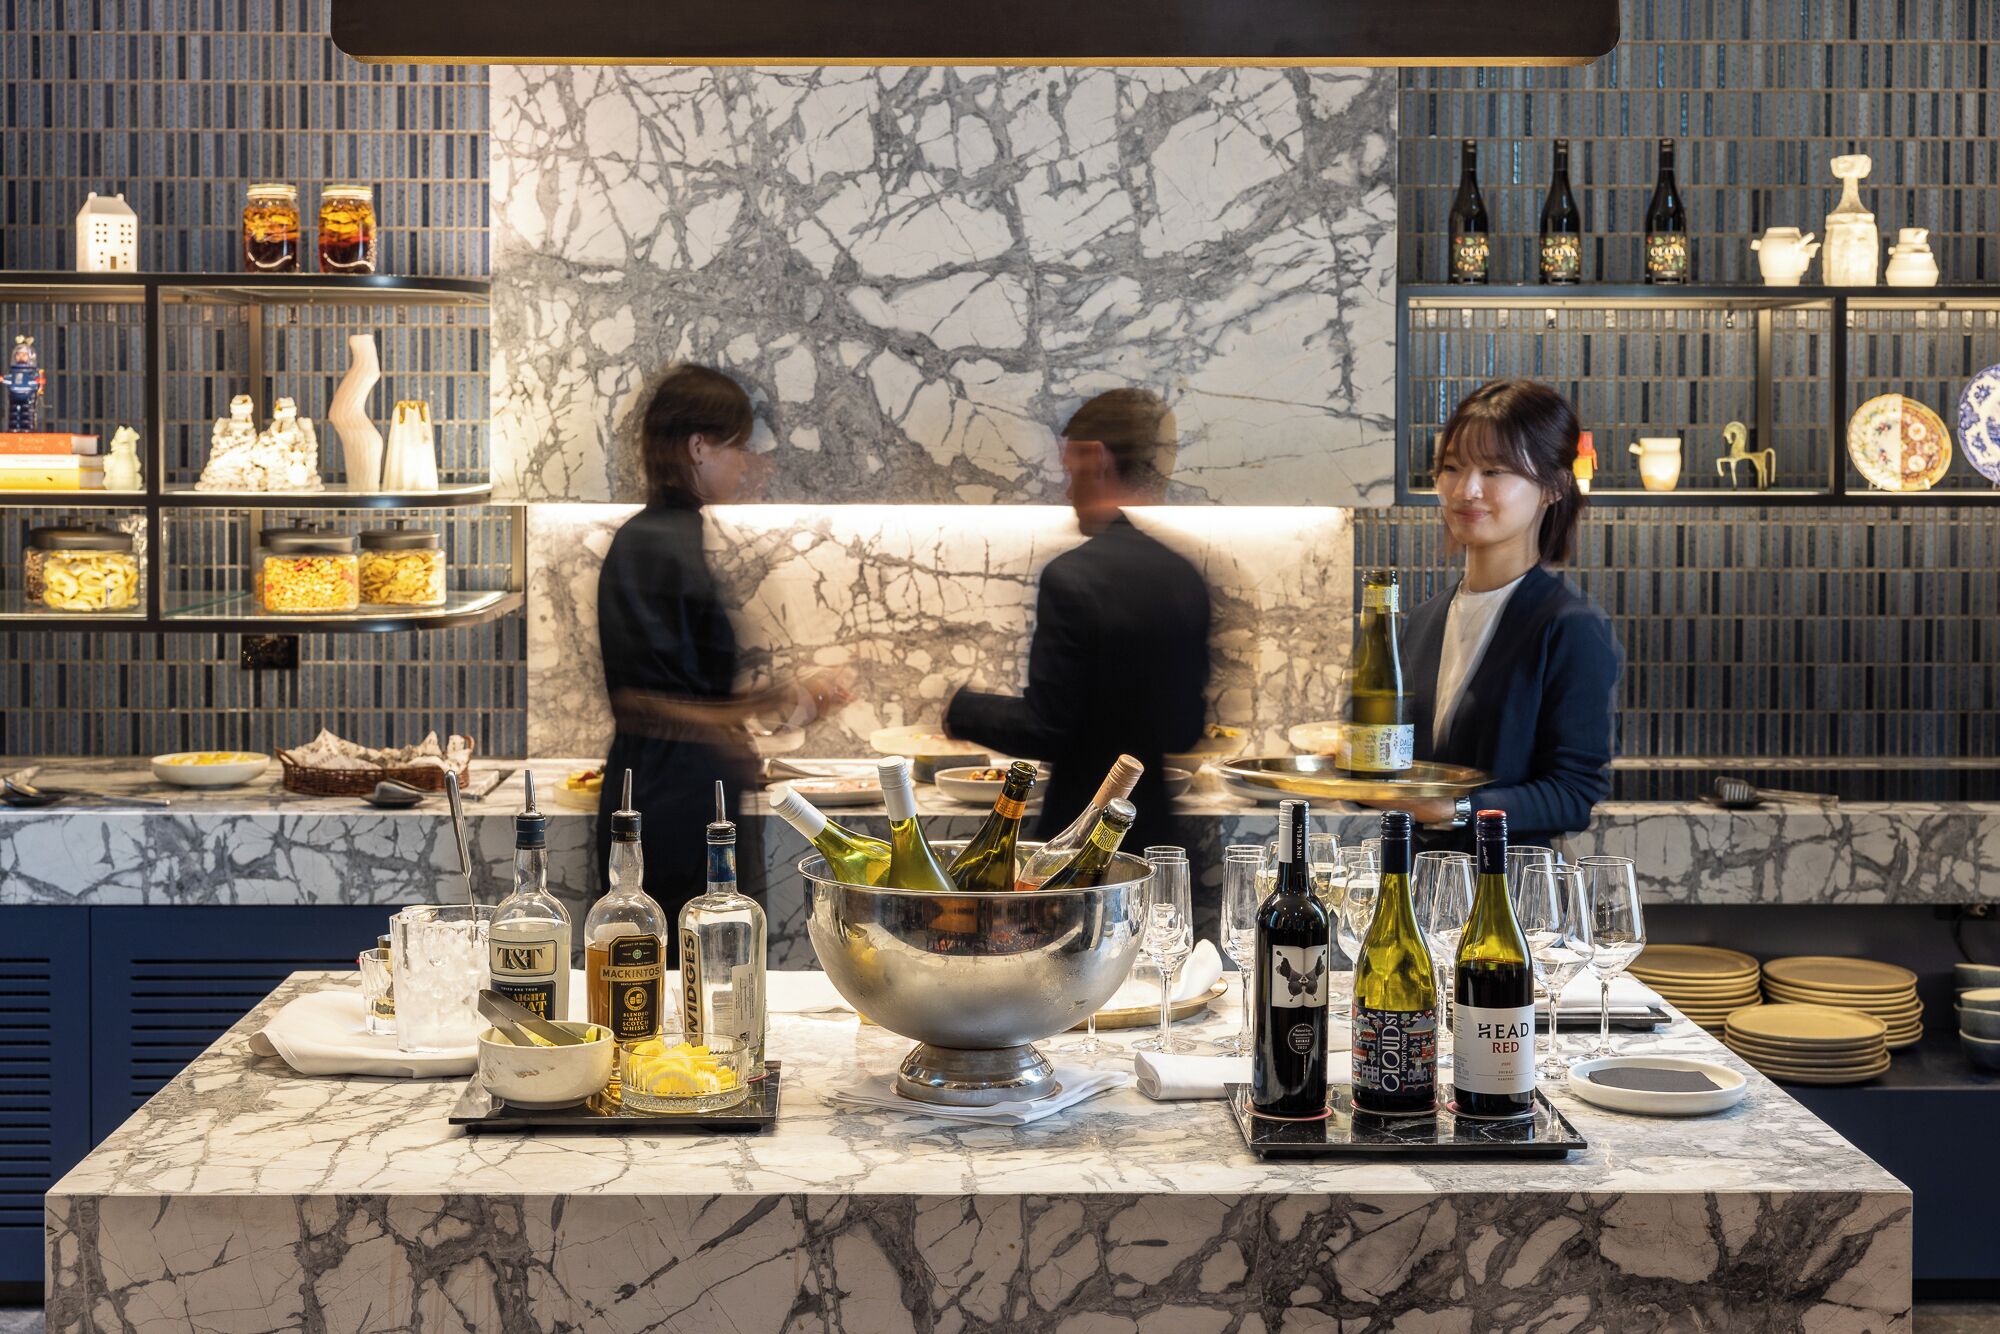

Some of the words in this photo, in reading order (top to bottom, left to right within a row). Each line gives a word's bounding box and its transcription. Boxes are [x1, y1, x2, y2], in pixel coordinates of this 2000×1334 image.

[496, 946, 543, 970] T&T
[1384, 1011, 1398, 1025] ST
[1477, 1022, 1529, 1039] HEAD
[1492, 1042, 1520, 1053] RED
[1381, 1025, 1400, 1092] CLOUD
